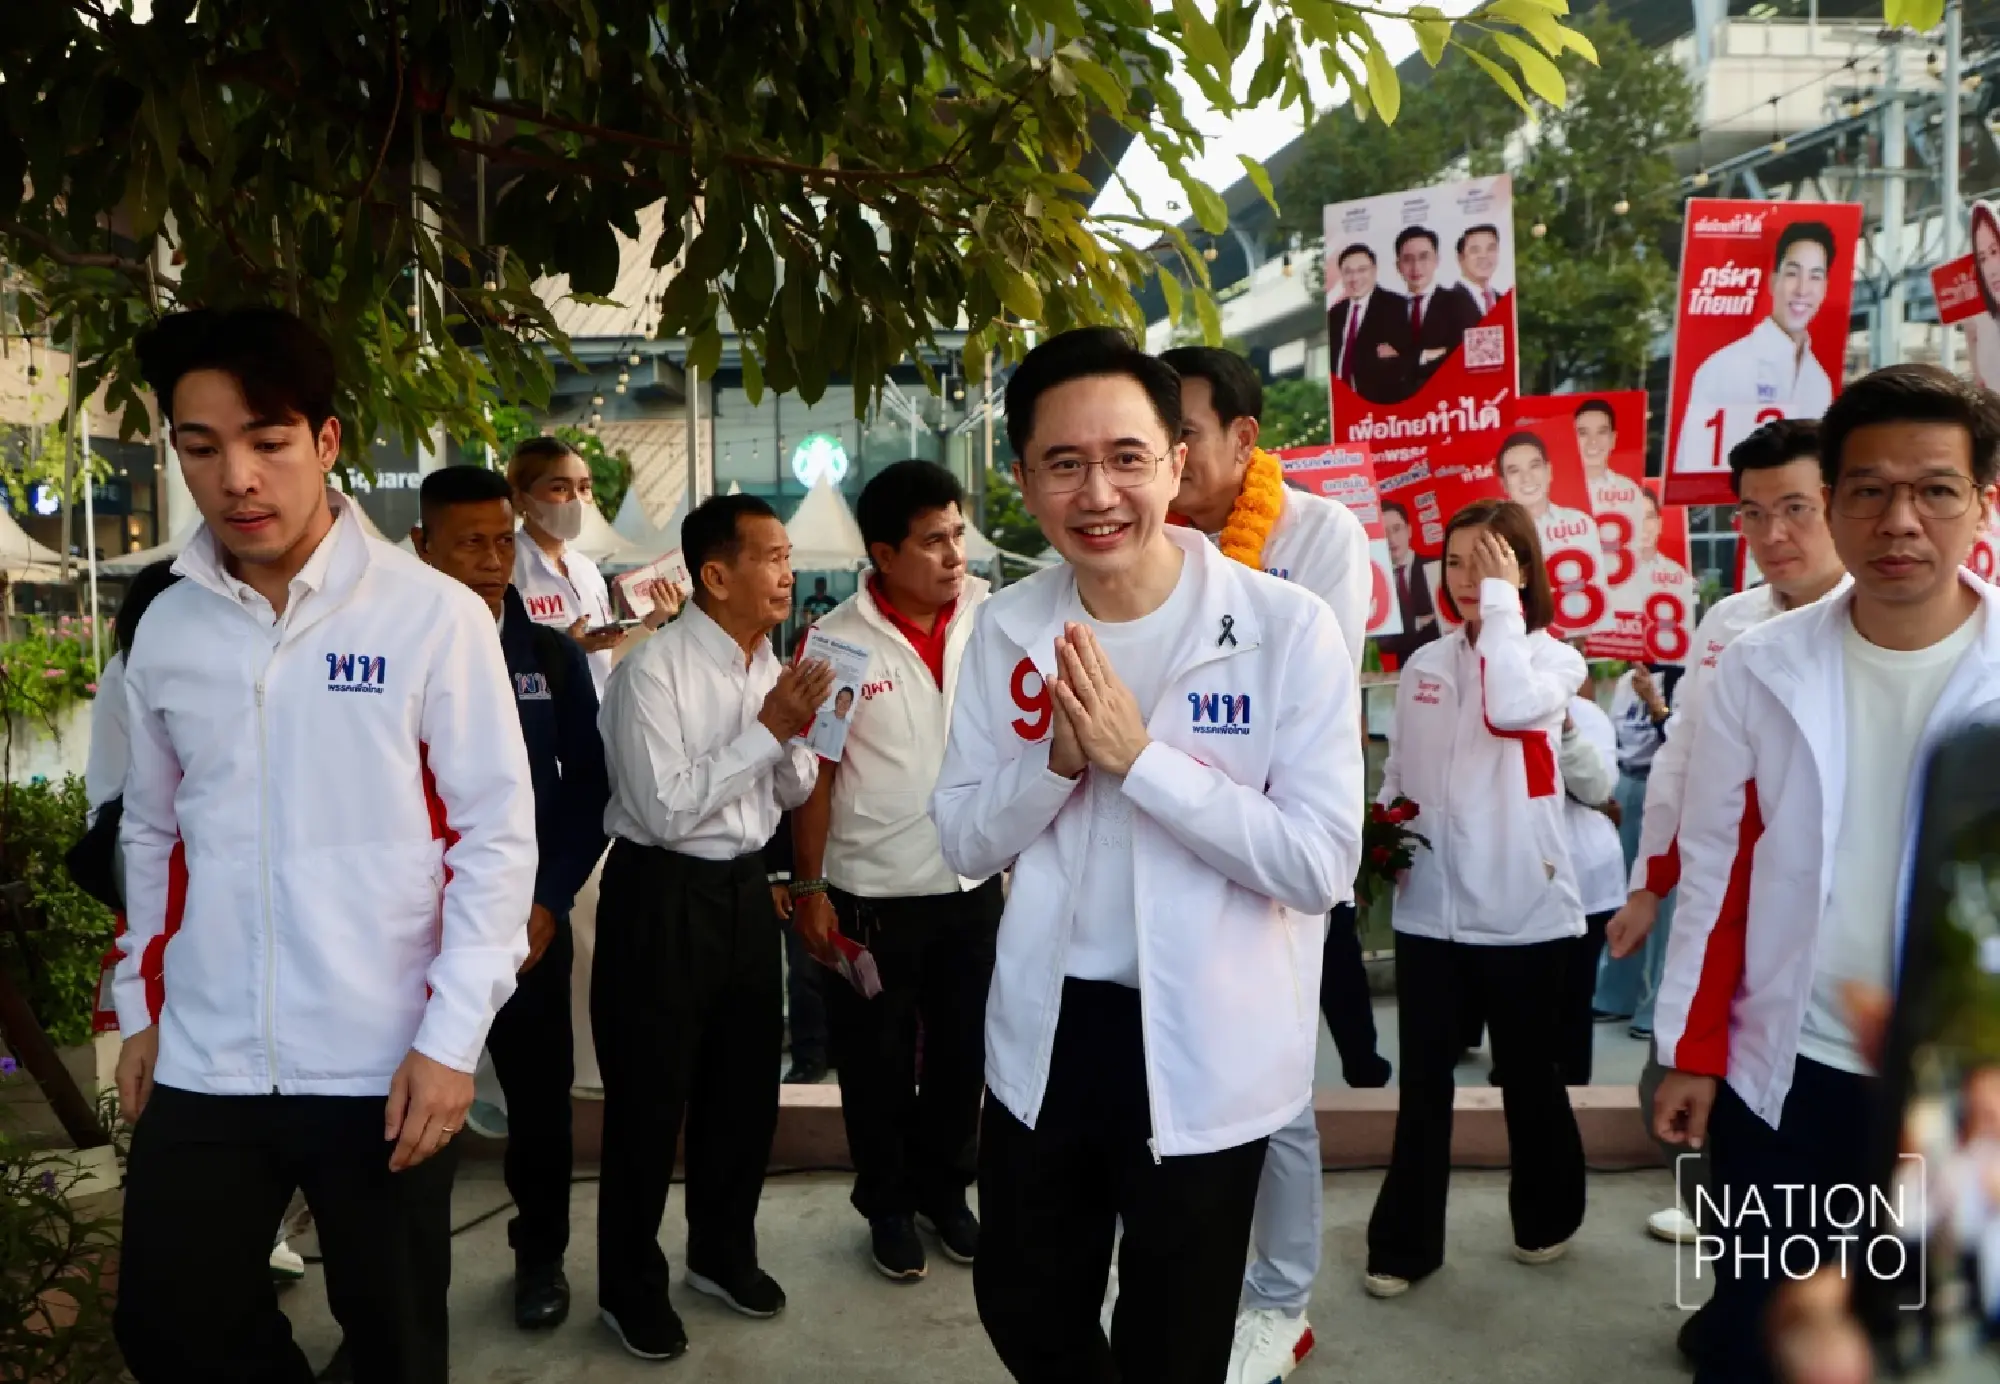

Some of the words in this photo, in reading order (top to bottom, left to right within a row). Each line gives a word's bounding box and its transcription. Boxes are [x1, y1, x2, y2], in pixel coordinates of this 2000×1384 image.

[1349, 388, 1509, 441] เพื่อไทยทำได้
[1545, 549, 1606, 629] 8
[1645, 593, 1690, 660] 8
[326, 653, 386, 684] พท
[1010, 657, 1053, 741] 9
[1188, 692, 1250, 723] พท
